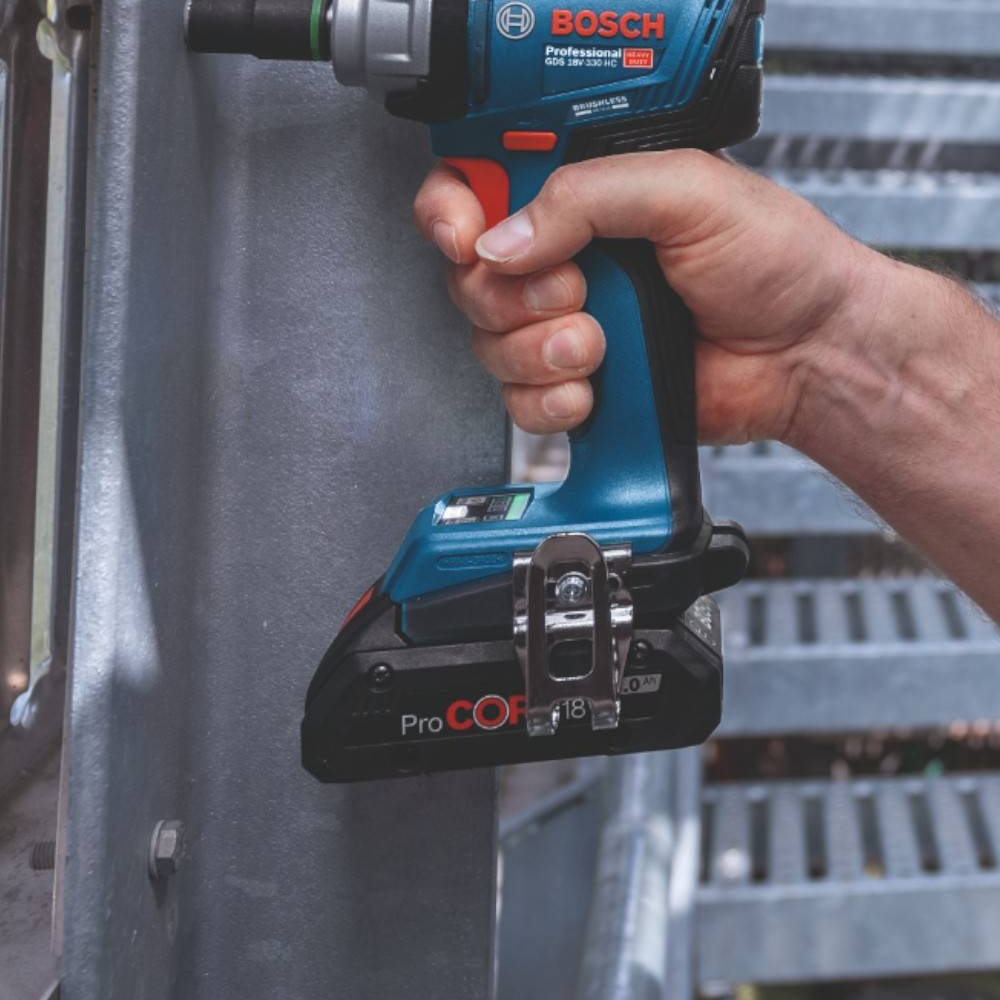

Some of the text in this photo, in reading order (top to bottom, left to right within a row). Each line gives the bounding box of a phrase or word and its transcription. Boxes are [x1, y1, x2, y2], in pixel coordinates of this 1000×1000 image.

[551, 9, 665, 40] BOSCH
[545, 46, 622, 58] Professional
[544, 57, 565, 66] GDS
[572, 96, 628, 111] BRUSHLESS
